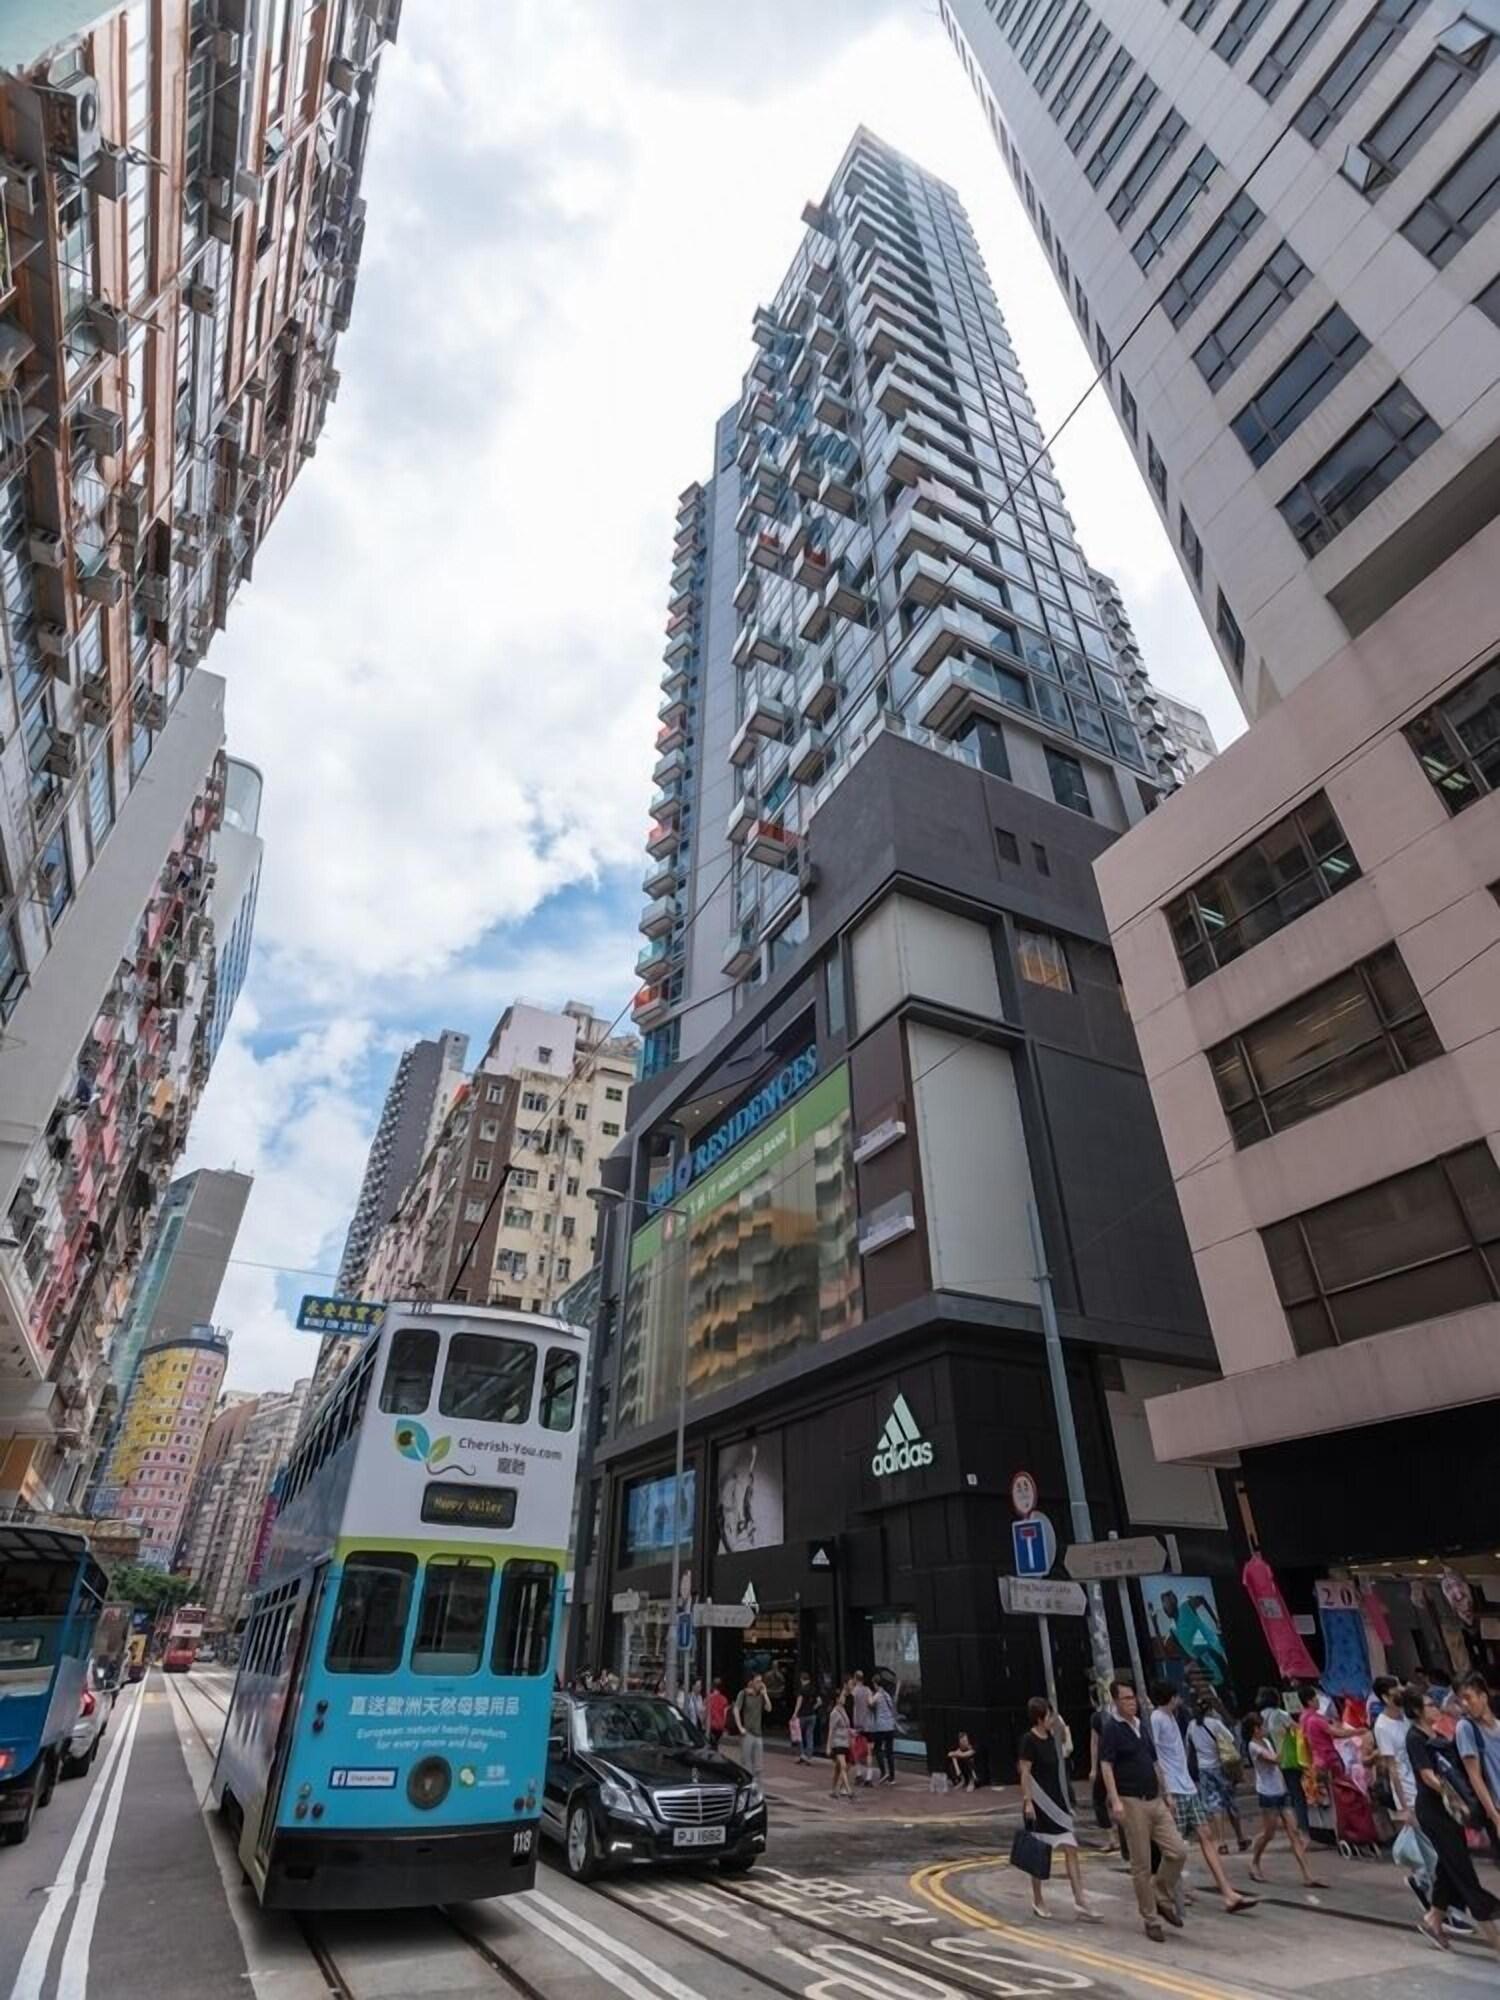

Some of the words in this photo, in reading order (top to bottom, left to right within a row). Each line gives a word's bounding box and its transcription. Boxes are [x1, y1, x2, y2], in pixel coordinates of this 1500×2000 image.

[458, 1437, 563, 1460] Cherish-You.com
[872, 1442, 934, 1477] adidas
[513, 1829, 533, 1854] 118
[677, 1830, 695, 1843] PJ
